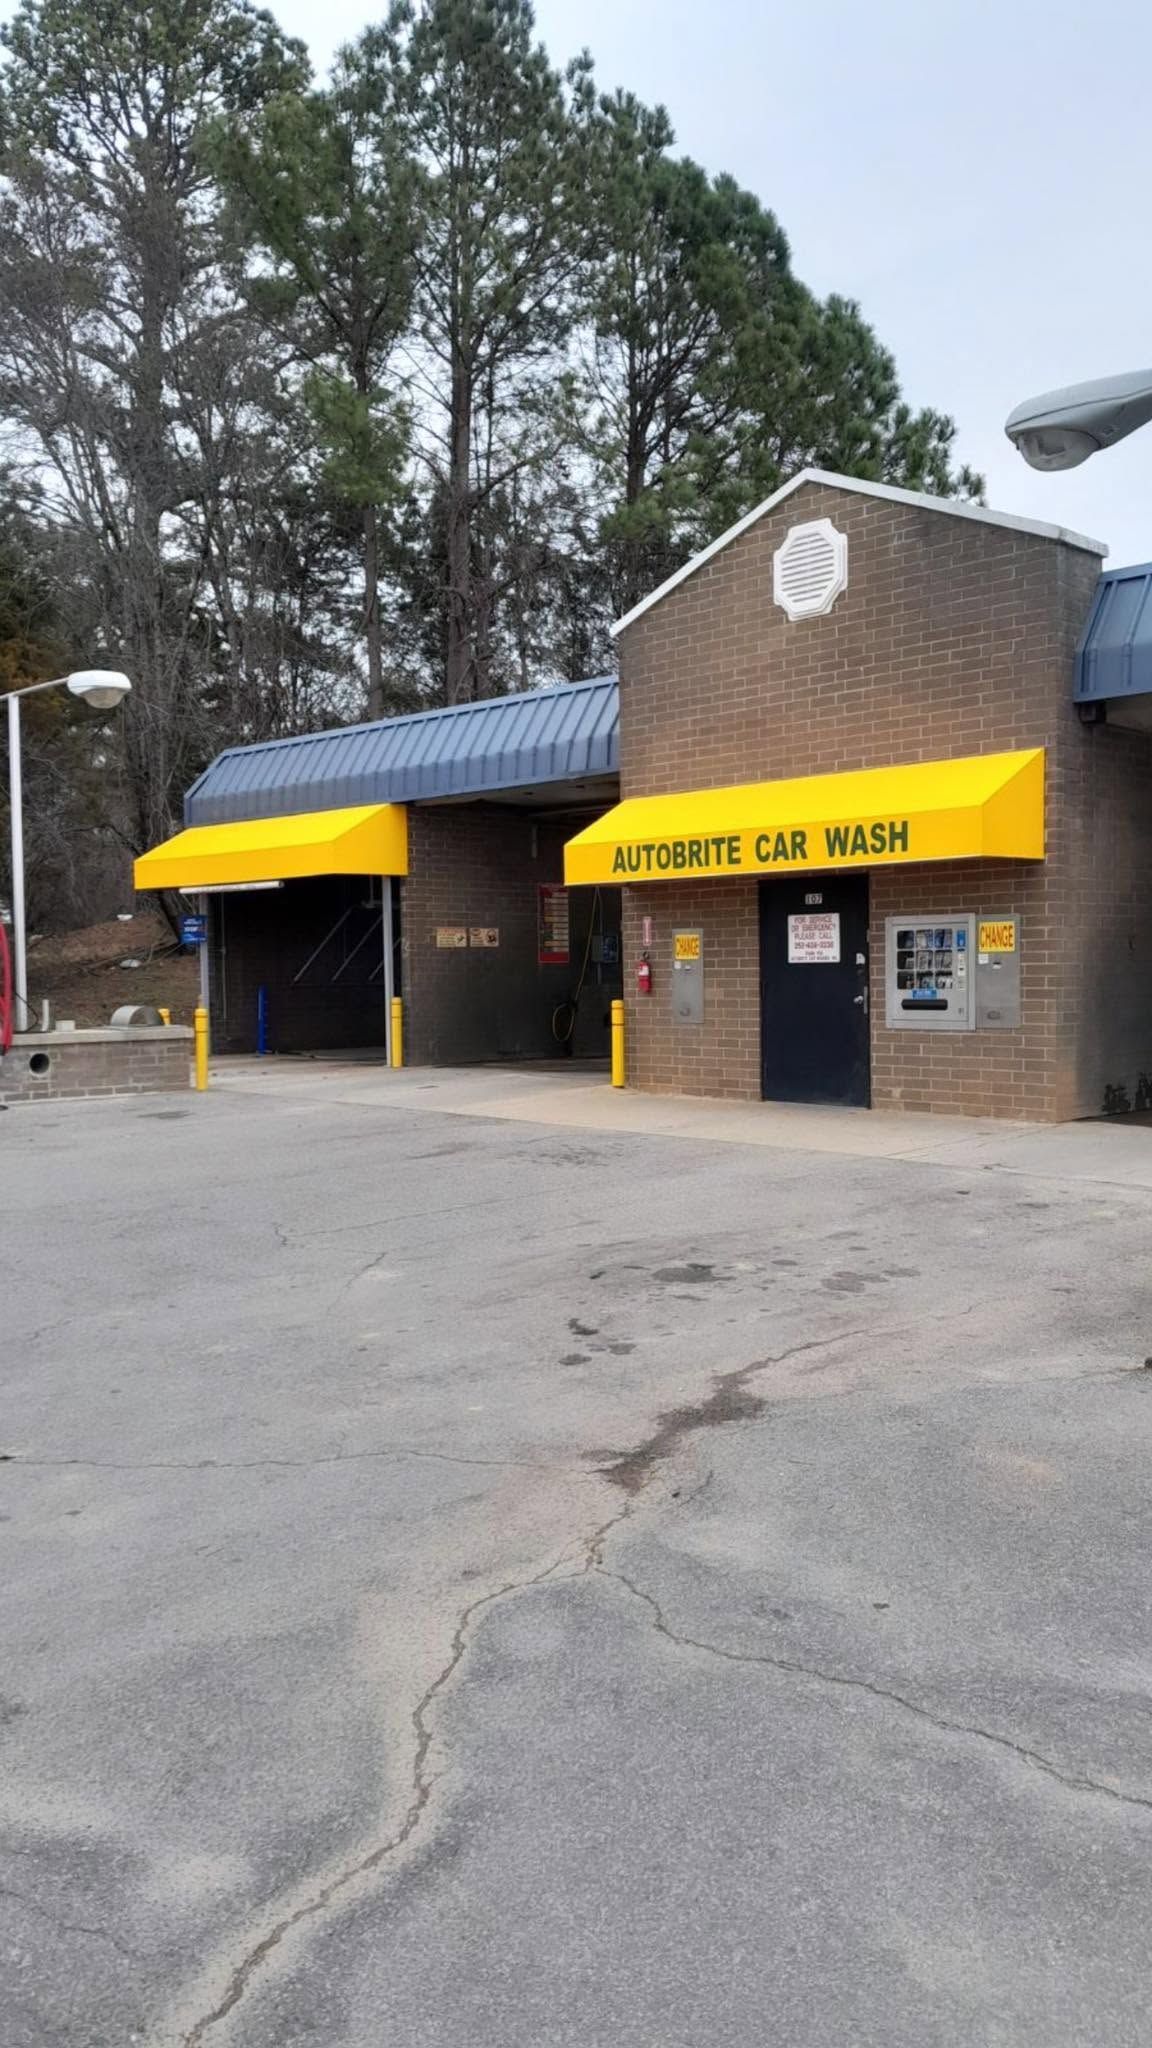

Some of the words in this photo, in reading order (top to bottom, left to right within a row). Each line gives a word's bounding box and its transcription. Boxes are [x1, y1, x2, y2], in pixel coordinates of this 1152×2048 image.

[612, 835, 741, 873] AUTOBRITE
[755, 830, 808, 863] CAR
[825, 820, 909, 858] WASH
[794, 932, 815, 940] PLEASE
[819, 931, 832, 939] CALL
[981, 925, 1013, 948] CHANGE
[676, 937, 699, 956] CHANGE
